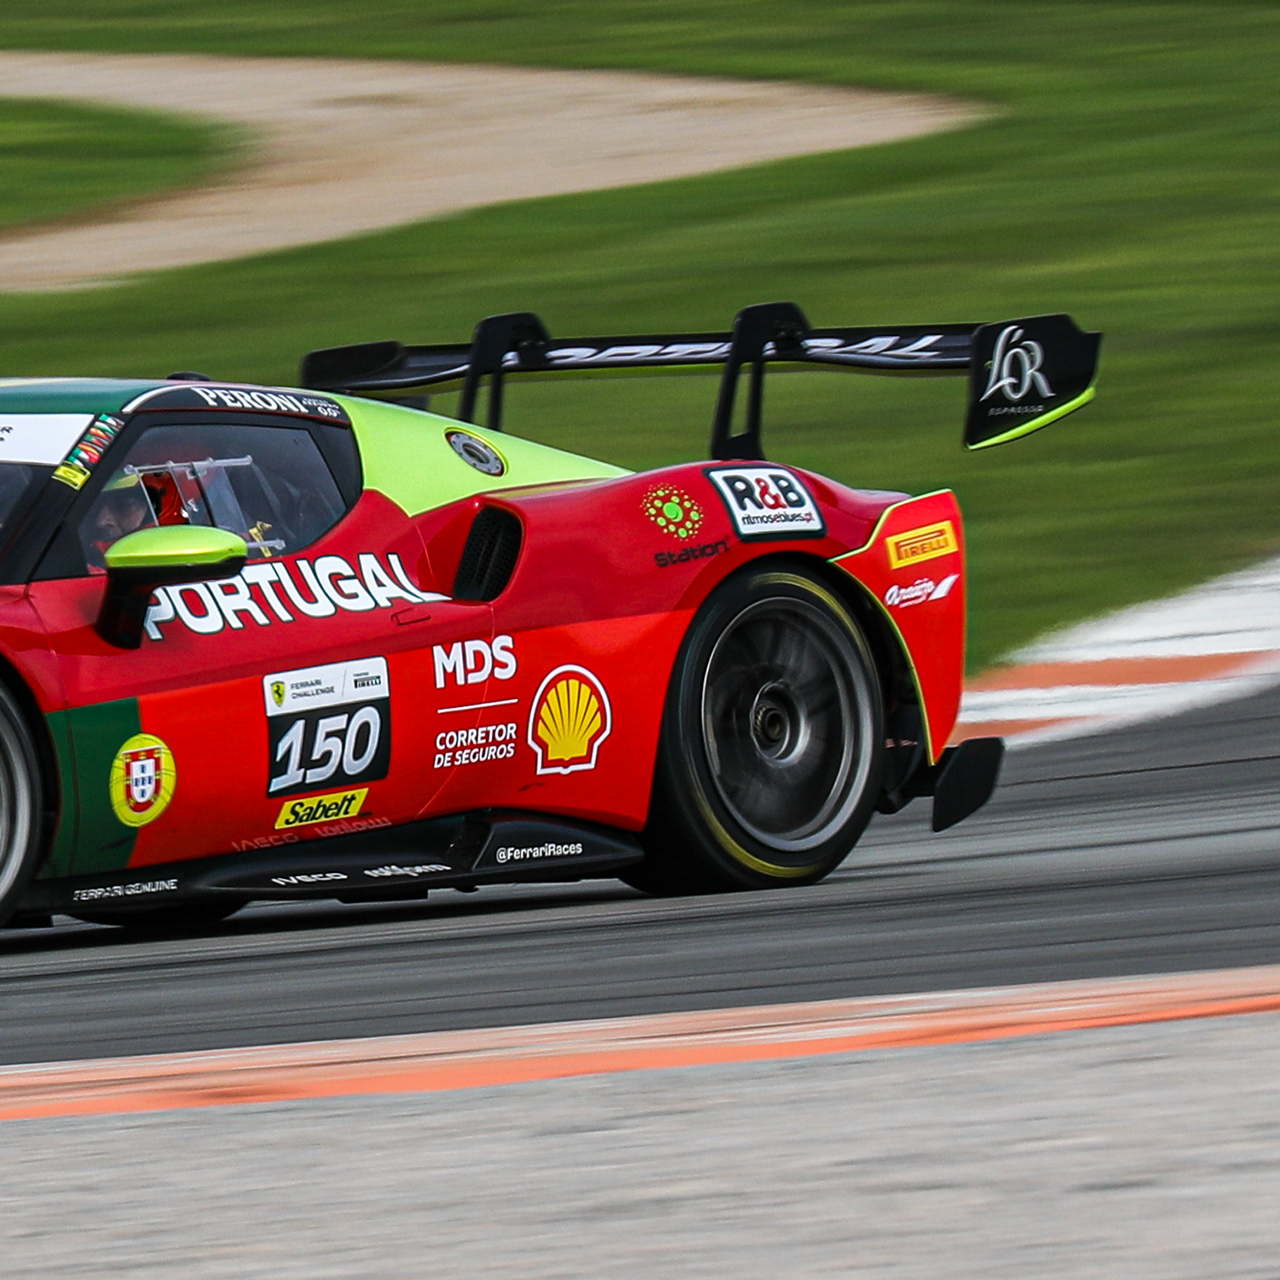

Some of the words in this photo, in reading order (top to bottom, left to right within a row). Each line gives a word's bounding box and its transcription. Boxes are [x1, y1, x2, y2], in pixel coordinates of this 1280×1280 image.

[191, 387, 309, 413] PERONI
[722, 474, 807, 511] R&B
[741, 511, 815, 526] ritmoseblues.pt
[654, 540, 729, 568] Station
[894, 528, 950, 561] PIRELLI
[143, 553, 453, 641] PORTUGAL
[432, 634, 518, 689] MDS
[290, 679, 323, 690] FERRARI
[291, 685, 335, 699] CHALLENGE
[353, 675, 382, 689] PIRELLI
[268, 705, 381, 793] 150
[435, 723, 517, 750] CORRETOR
[433, 752, 452, 768] DE
[454, 742, 516, 766] SEGUROS
[284, 793, 357, 826] Sabelt
[495, 842, 583, 863] @FerrariRaces
[125, 878, 179, 896] GENUINE
[271, 872, 348, 886] IVECO
